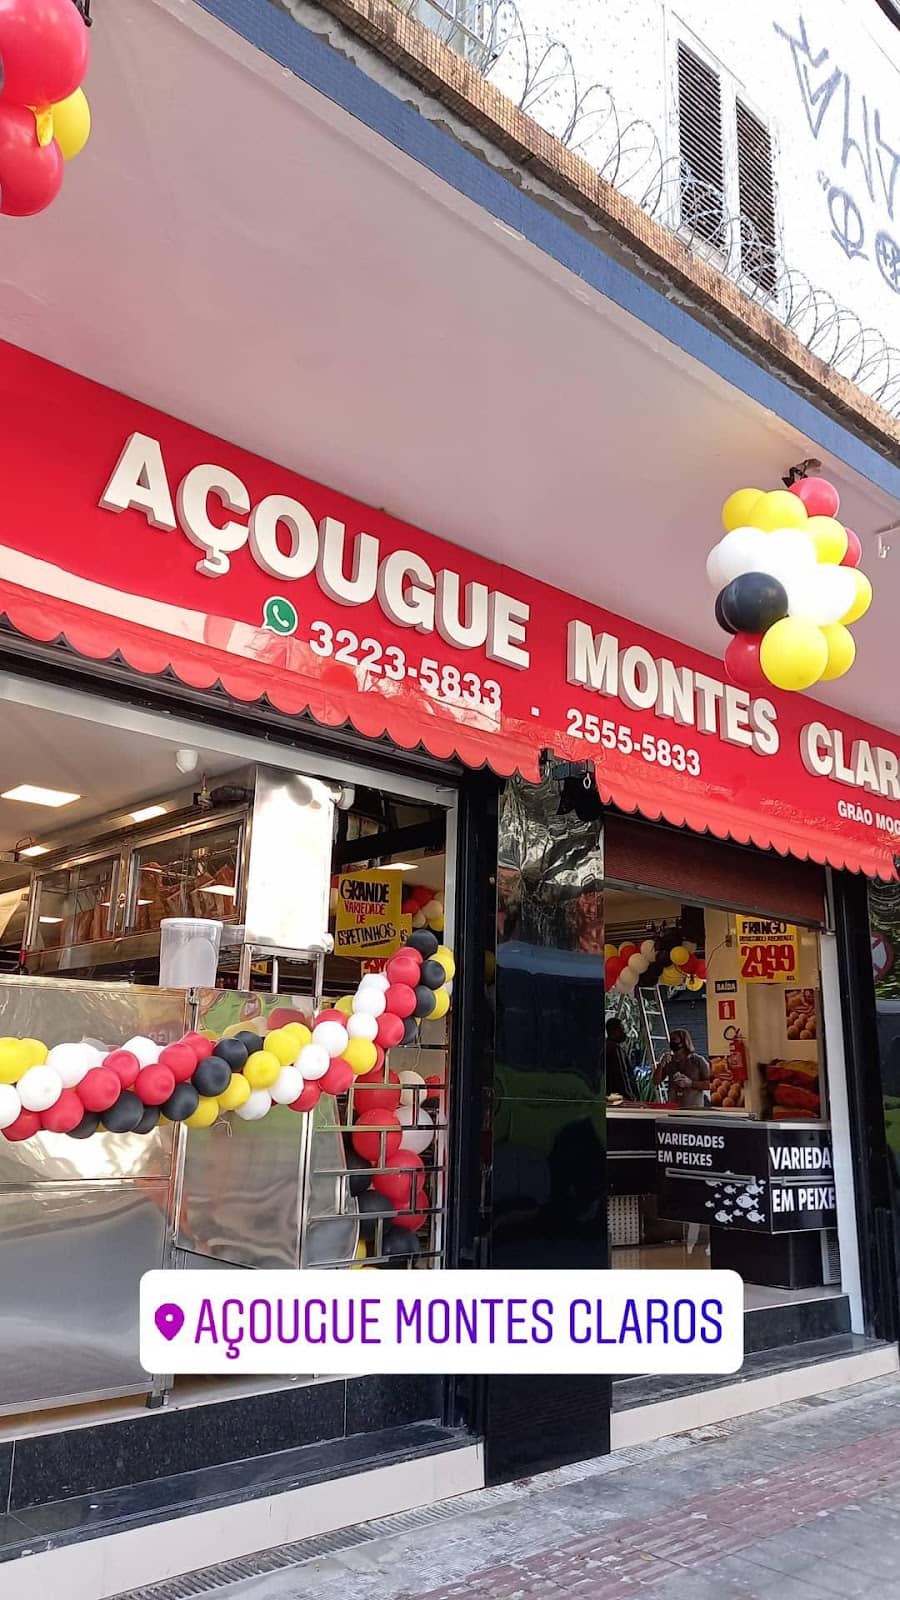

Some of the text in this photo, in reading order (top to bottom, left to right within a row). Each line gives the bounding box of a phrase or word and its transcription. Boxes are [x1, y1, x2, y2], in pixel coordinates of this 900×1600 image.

[98, 431, 530, 672] AÇOUGUE
[566, 619, 780, 757] MONTES
[309, 620, 701, 776] 3223-5833 2555-5833
[837, 800, 873, 826] GRÃO
[340, 879, 390, 904] GRANDE
[344, 900, 386, 916] VARIEDADE
[356, 913, 366, 925] DE
[337, 922, 397, 946] ESPETINHOS
[742, 921, 788, 935] FRANGO
[657, 1132, 725, 1149] VARIEDADES
[657, 1151, 713, 1167] EM PEIXES
[769, 1147, 832, 1170] VARIEDA
[772, 1188, 795, 1213] EM
